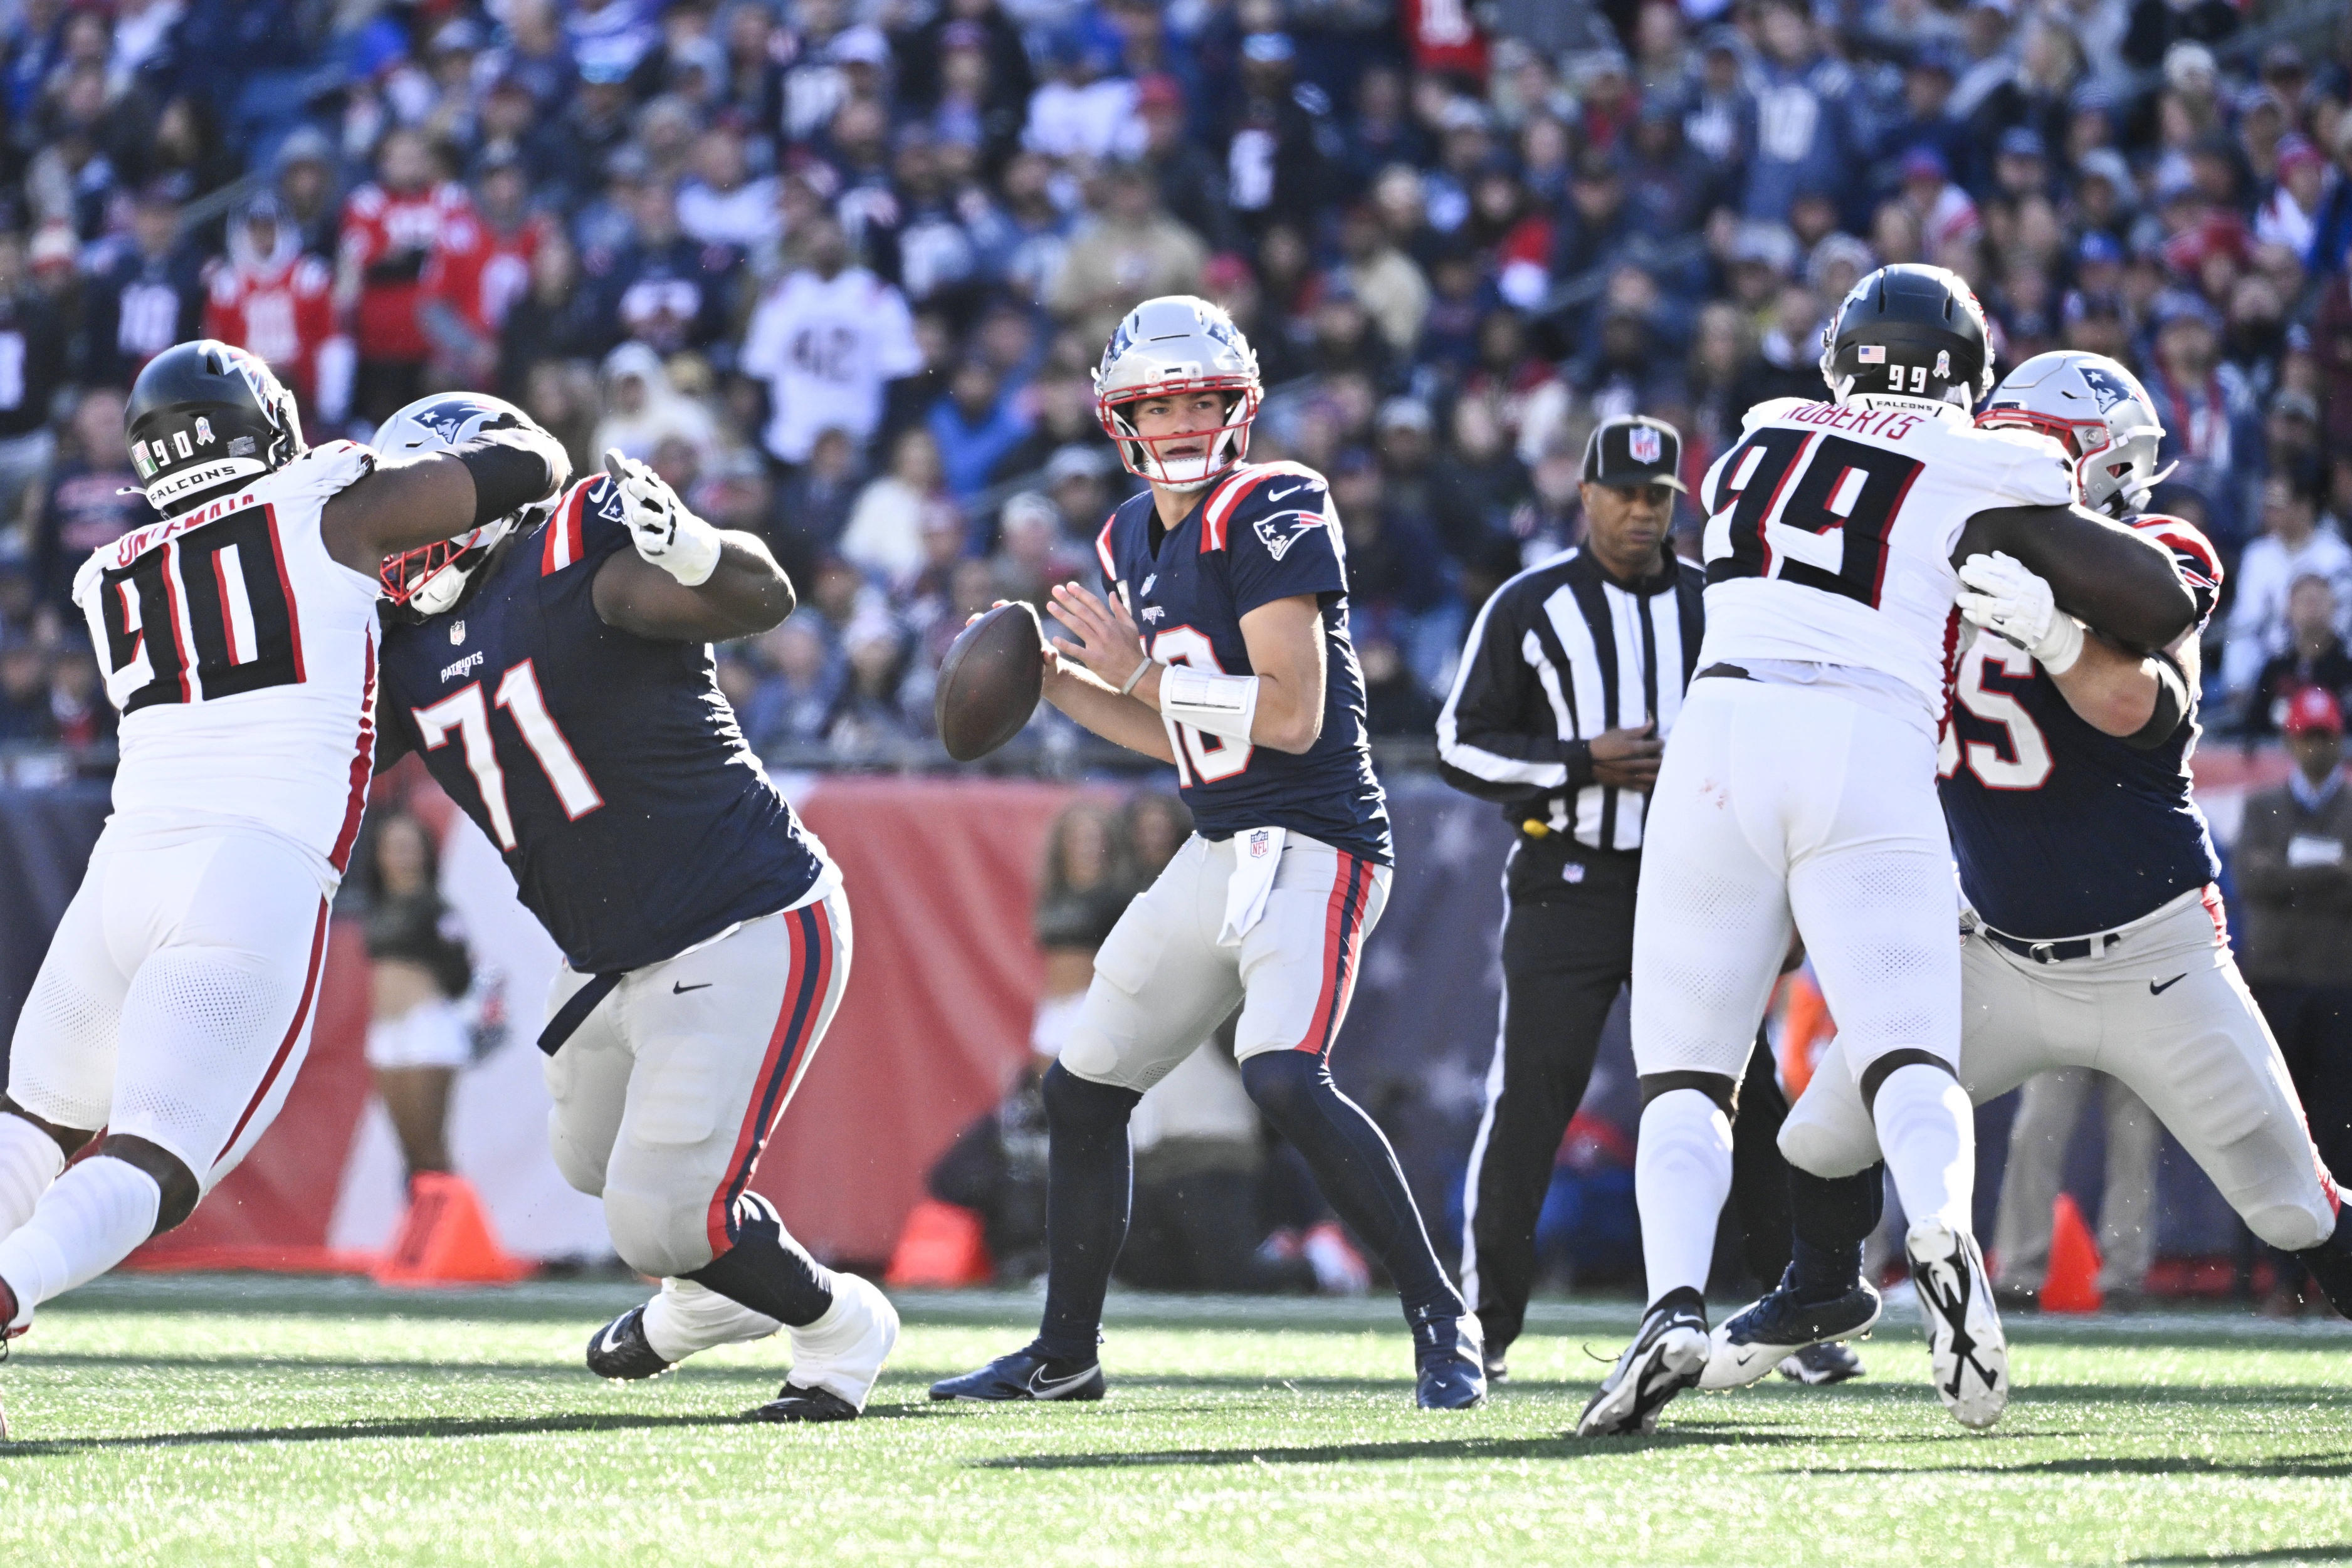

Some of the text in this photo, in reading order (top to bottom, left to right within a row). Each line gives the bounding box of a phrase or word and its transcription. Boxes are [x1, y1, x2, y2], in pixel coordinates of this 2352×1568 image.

[1888, 364, 1928, 394] 99
[1876, 400, 1933, 412] FALCONS
[152, 430, 194, 467] 90
[150, 466, 236, 503] FALCONS
[1705, 427, 1926, 612] 99
[100, 503, 307, 717] 90
[441, 651, 484, 684] PATRIOTS
[411, 657, 605, 852] 71
[1252, 842, 1267, 855] NFL
